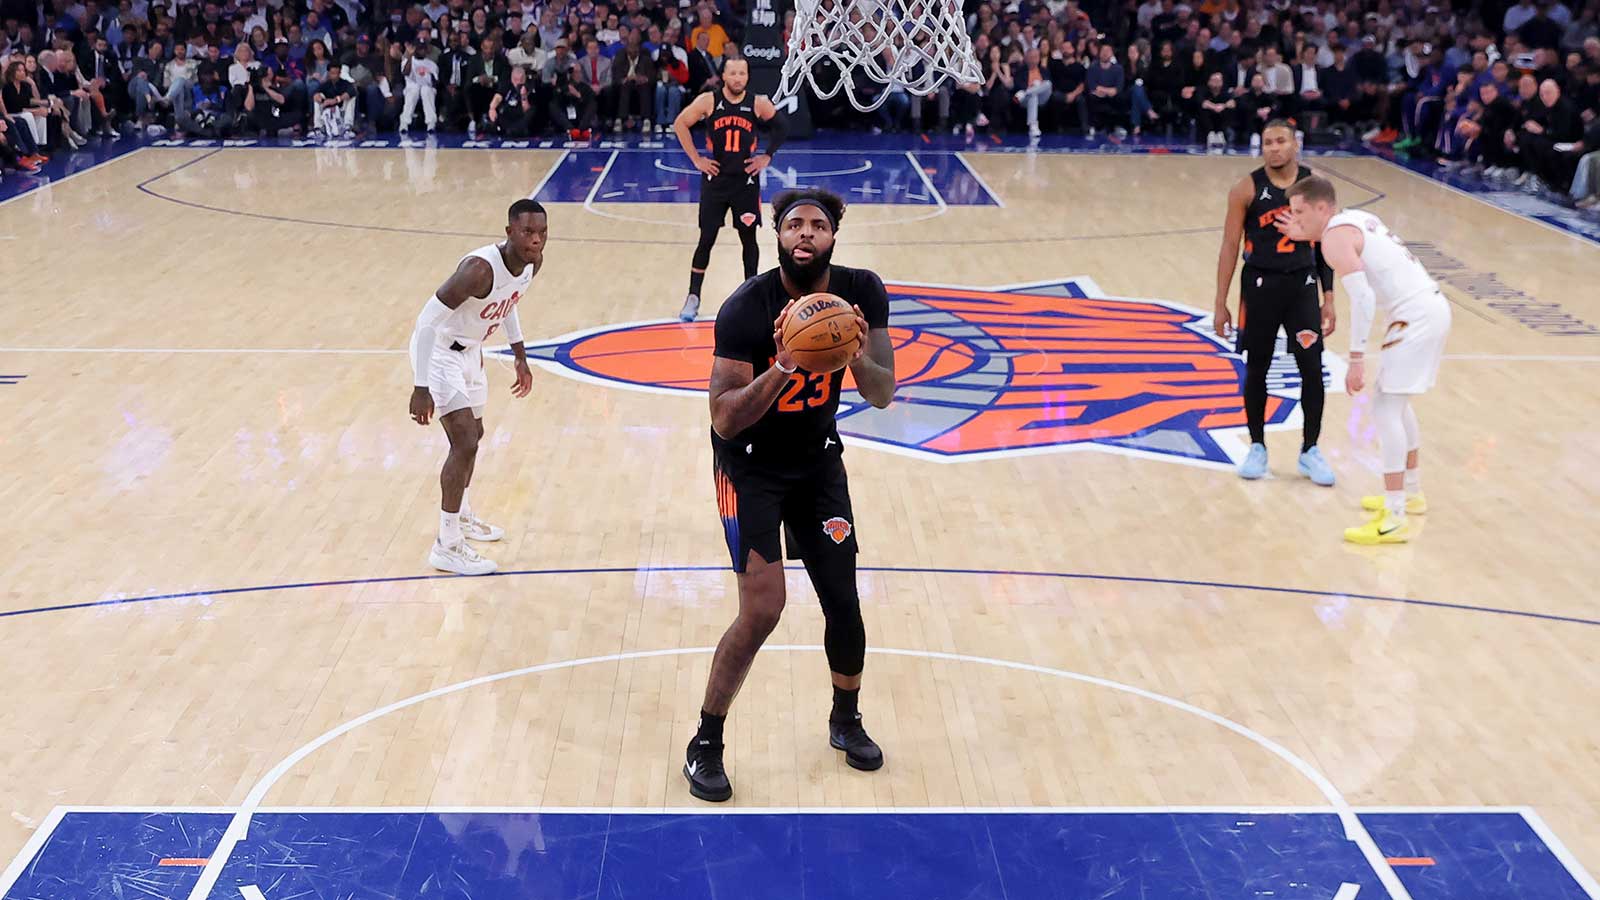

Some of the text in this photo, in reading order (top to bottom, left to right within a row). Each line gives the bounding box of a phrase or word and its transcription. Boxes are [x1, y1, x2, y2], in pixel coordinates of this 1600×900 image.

[743, 44, 781, 60] Google
[714, 116, 732, 130] NEW
[462, 140, 664, 148] KNICKS
[725, 130, 740, 152] 11
[798, 300, 845, 320] Wilson
[886, 284, 1283, 454] KNICKS
[778, 372, 832, 412] 23
